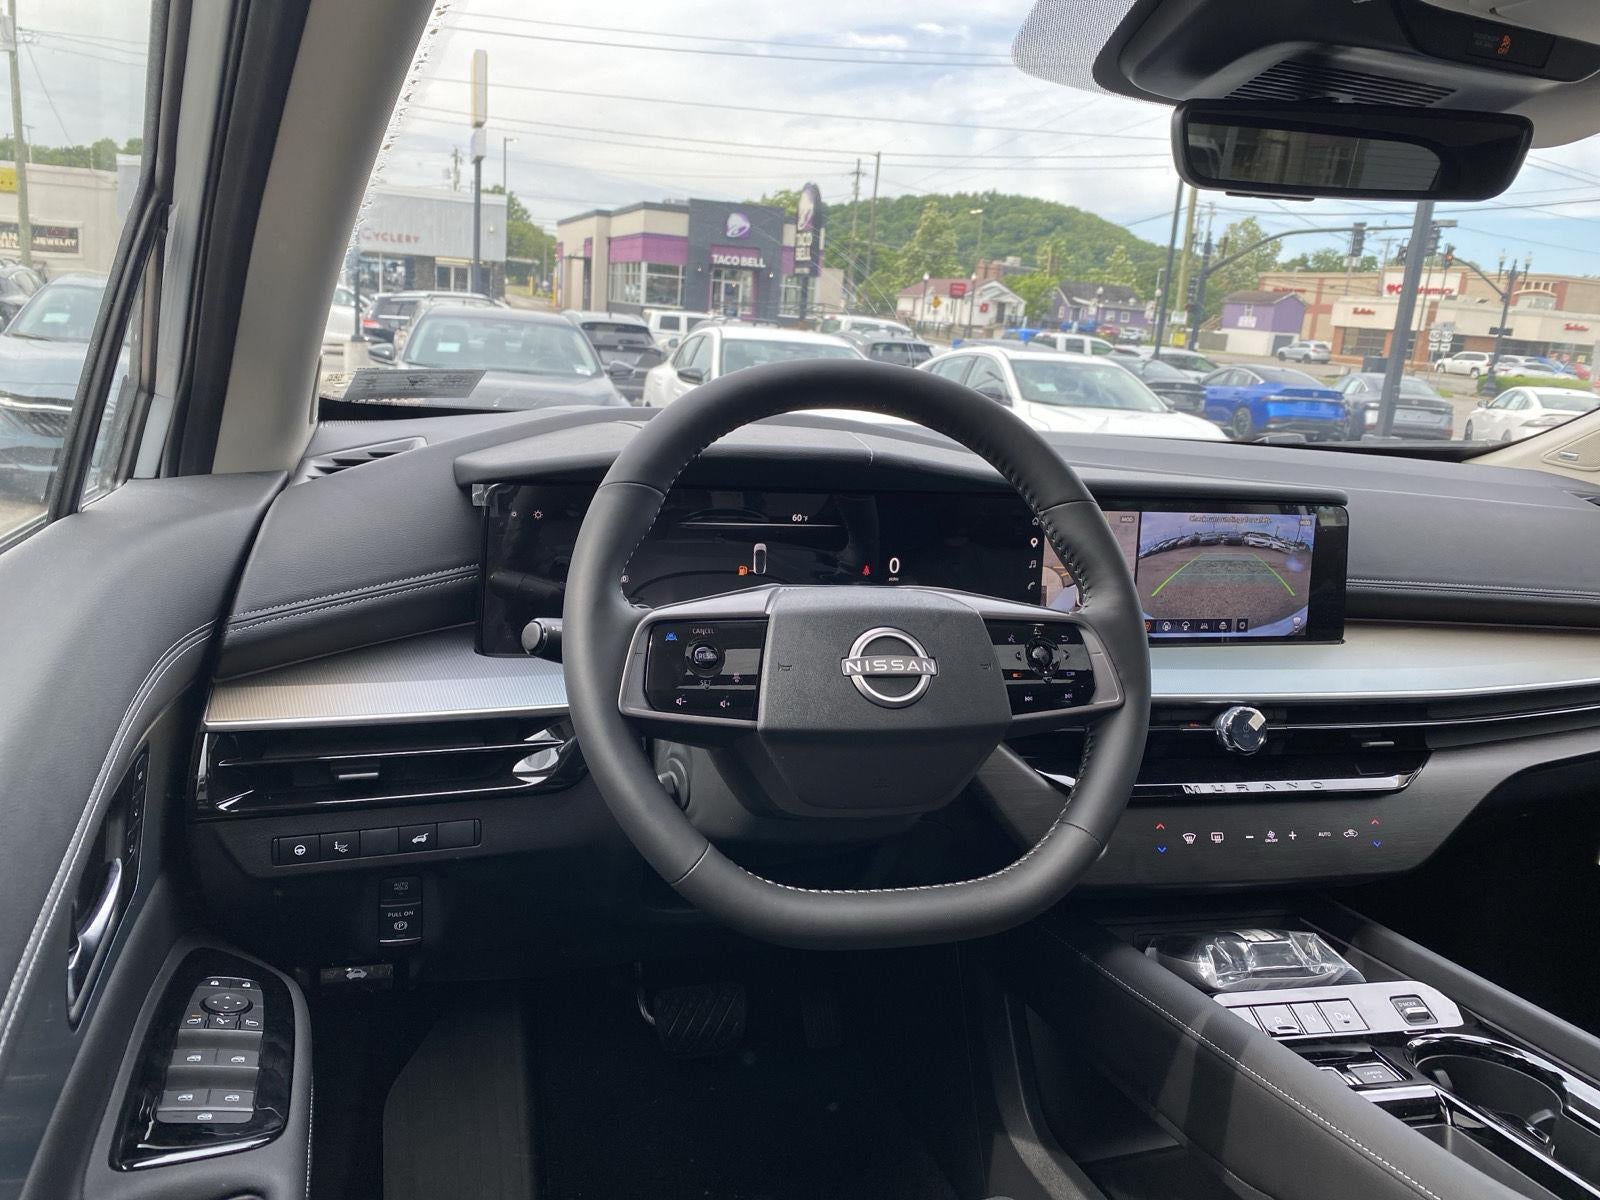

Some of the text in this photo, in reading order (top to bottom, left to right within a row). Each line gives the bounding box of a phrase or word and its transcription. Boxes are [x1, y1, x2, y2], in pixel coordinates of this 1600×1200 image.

[33, 236, 77, 247] JEWELRY
[712, 254, 766, 268] TACO BELL
[792, 513, 803, 522] 60
[889, 557, 900, 574] 0
[845, 660, 935, 673] NISSAN
[1183, 781, 1324, 795] MURANO
[1275, 1016, 1283, 1024] R
